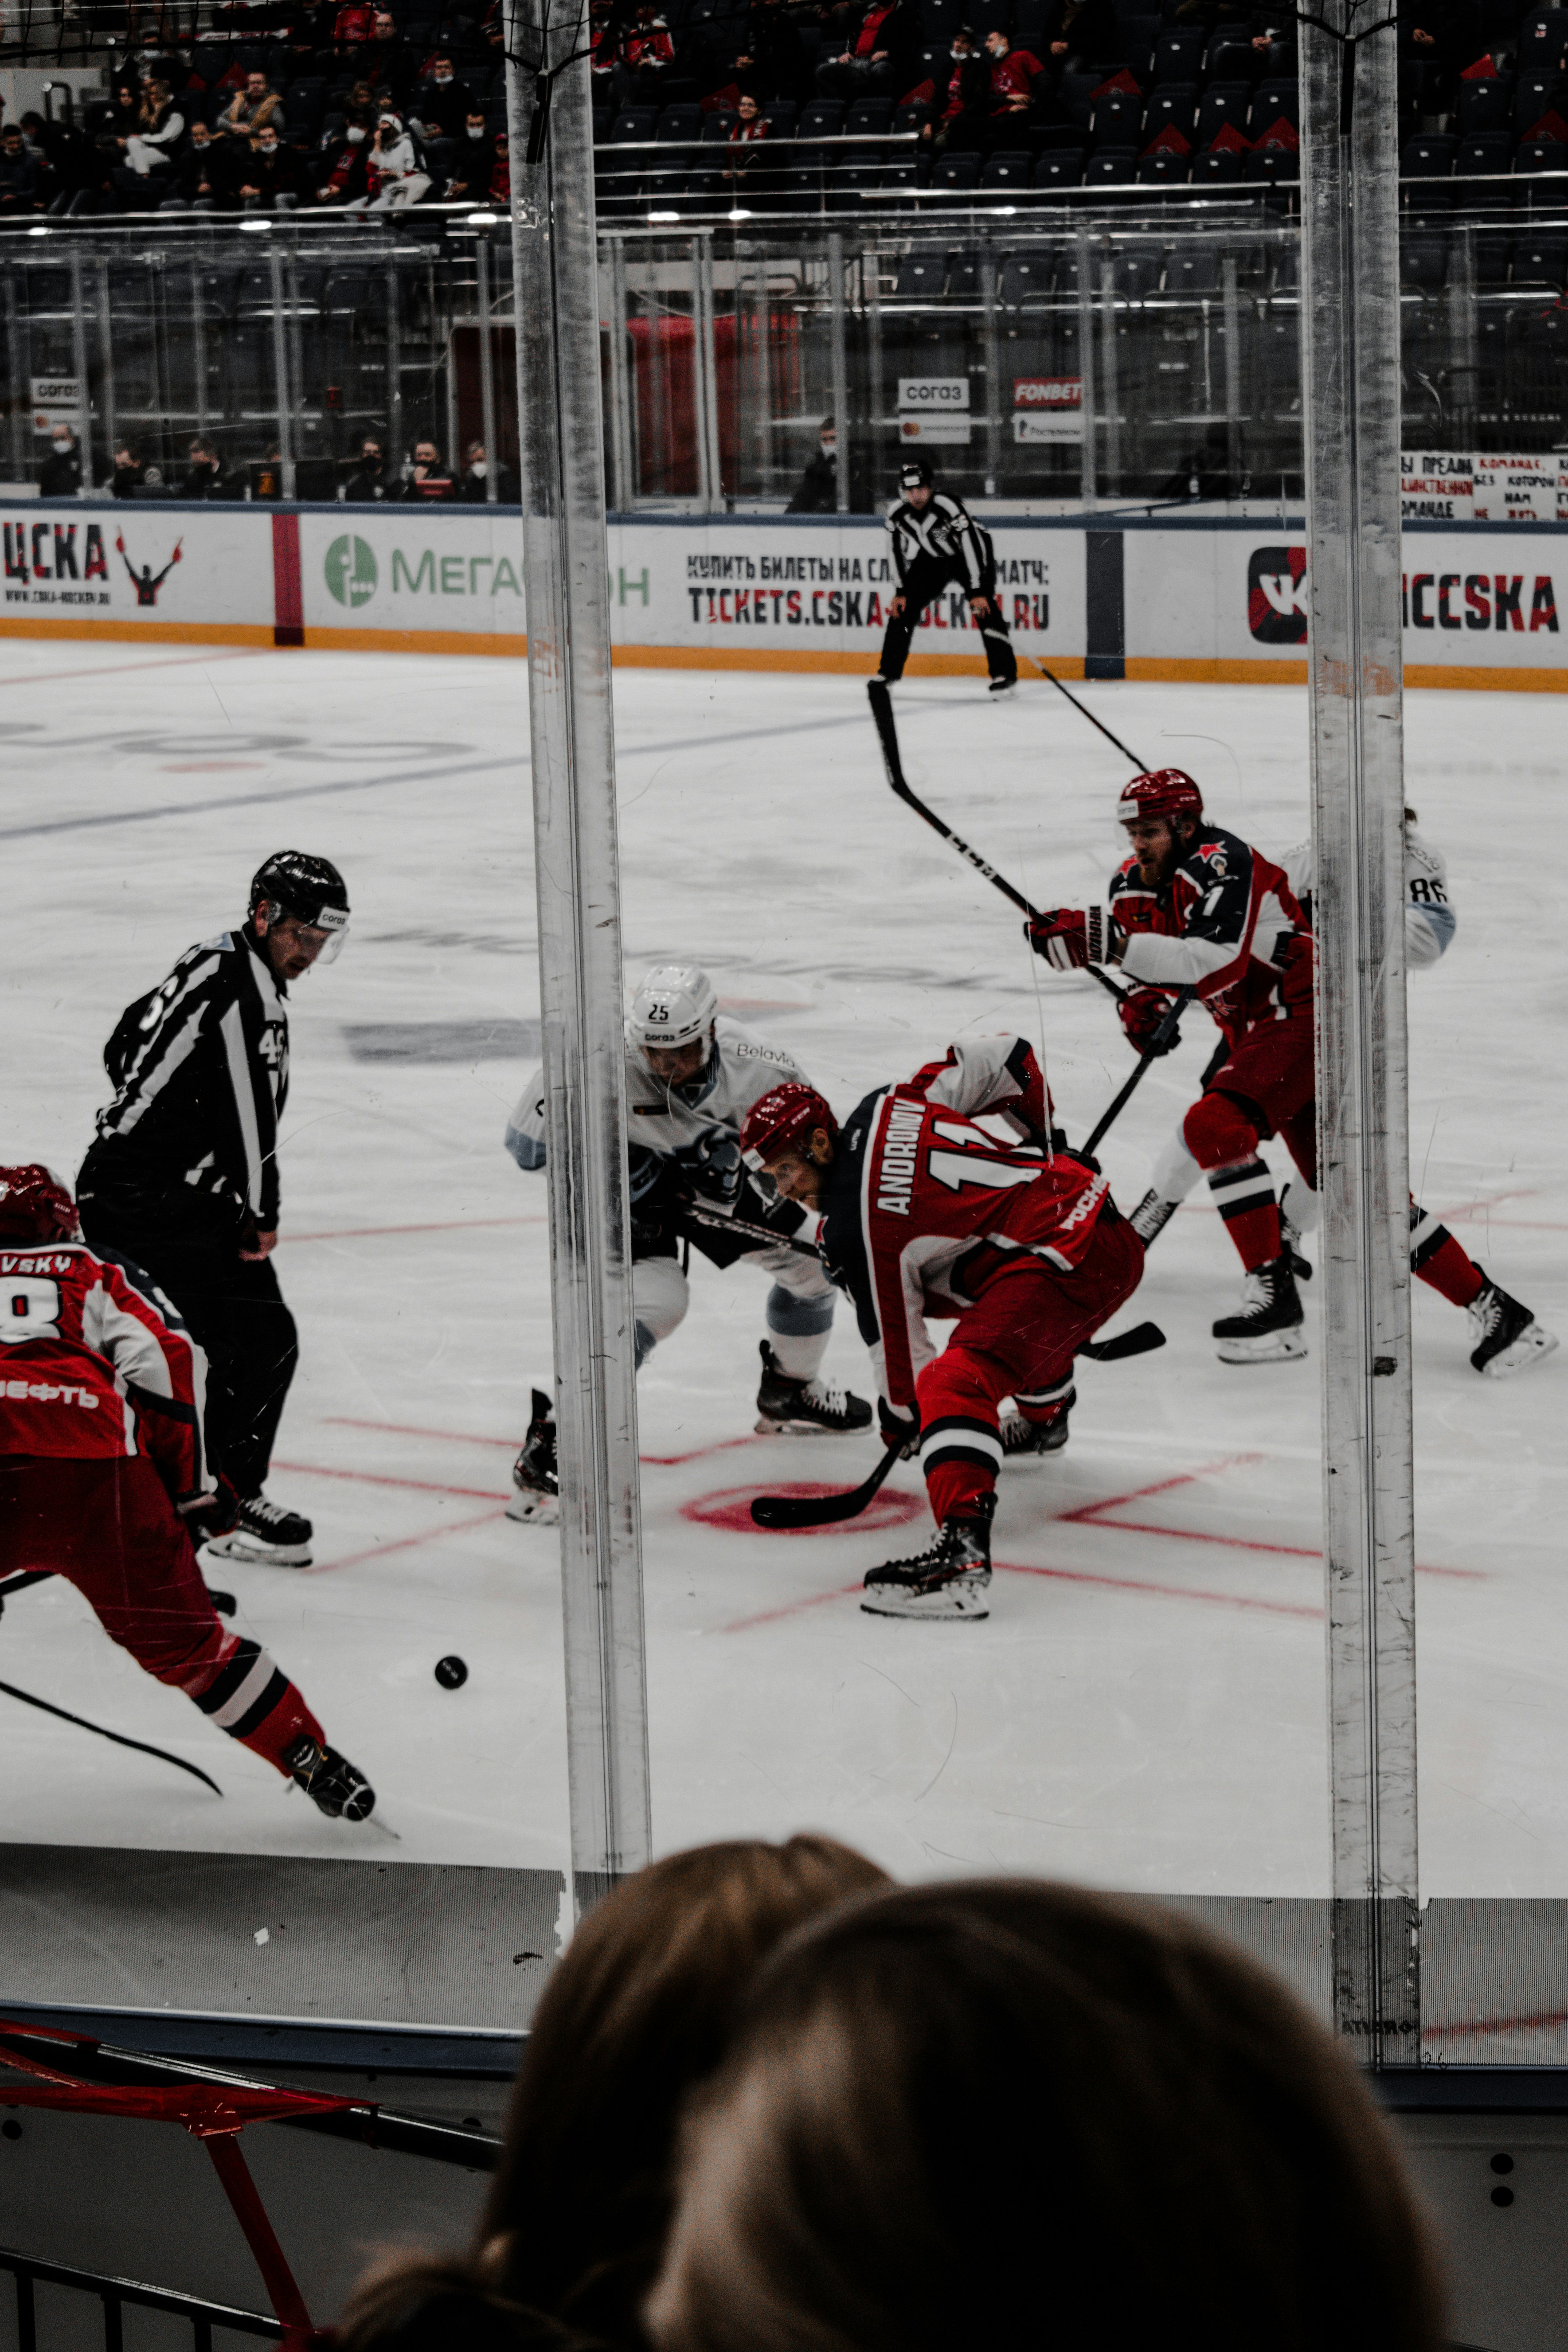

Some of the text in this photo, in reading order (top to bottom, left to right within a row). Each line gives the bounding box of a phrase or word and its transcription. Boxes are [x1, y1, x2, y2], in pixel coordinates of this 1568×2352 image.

[1015, 384, 1083, 402] FONBET
[3, 522, 110, 586] ЦСКА
[688, 555, 755, 580] КУПИТЬ
[761, 556, 834, 581] БИЛЕТЫ
[840, 558, 862, 582] НА
[648, 1004, 669, 1020] 25
[737, 1043, 796, 1068] Belavia
[877, 1098, 927, 1216] ANDRONOV
